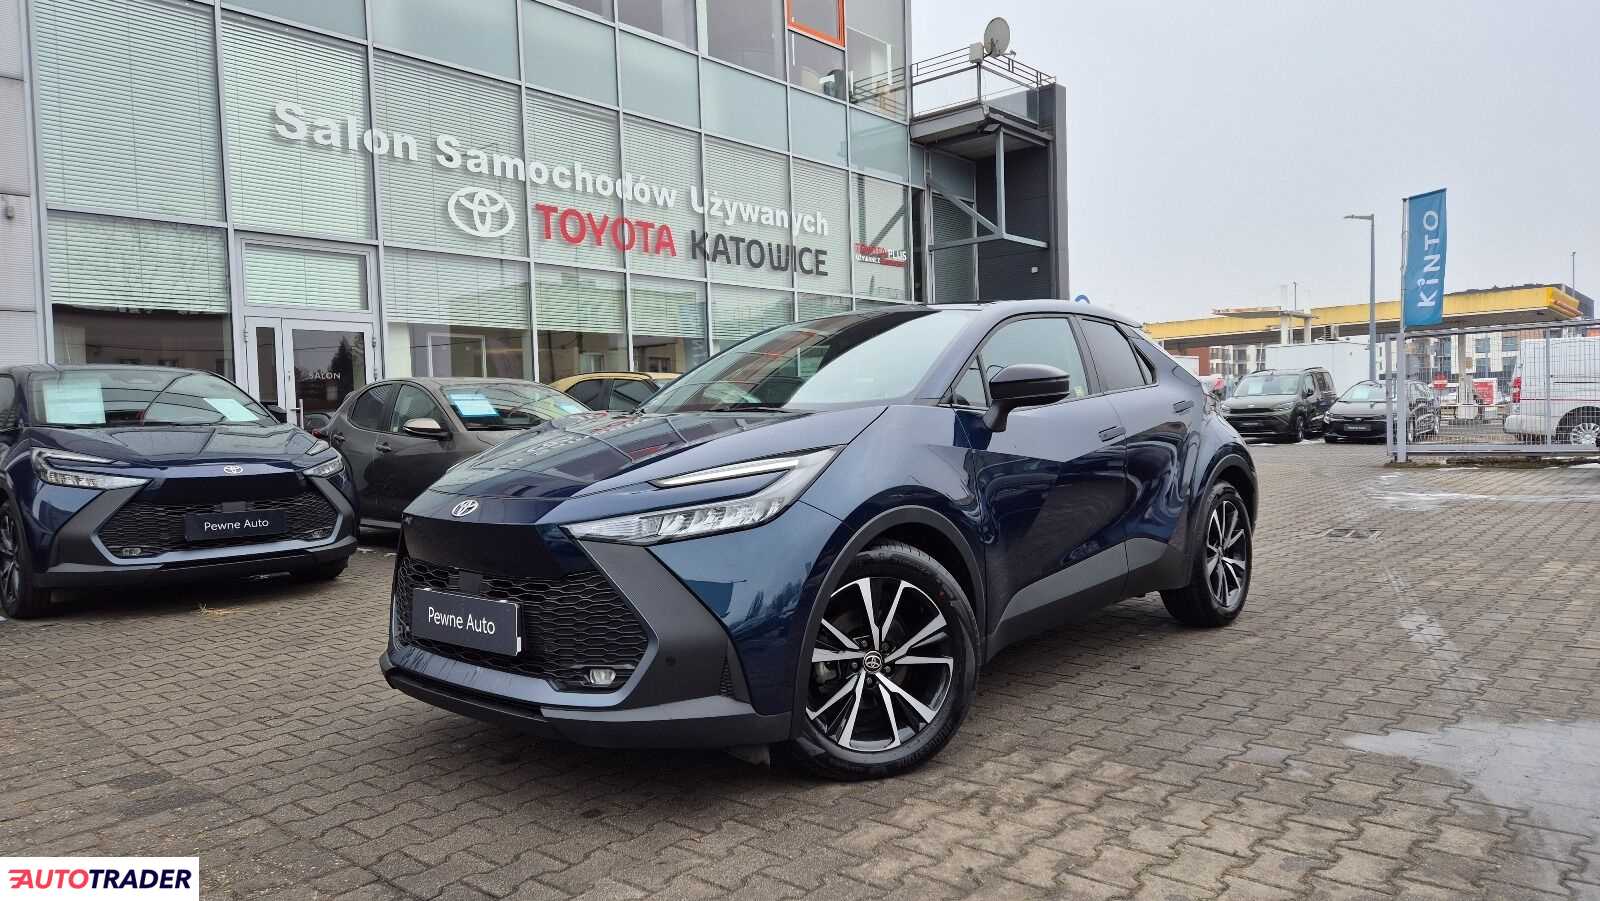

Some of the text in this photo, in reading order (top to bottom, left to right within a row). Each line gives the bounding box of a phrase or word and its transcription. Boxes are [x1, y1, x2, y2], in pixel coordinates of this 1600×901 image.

[274, 100, 829, 236] Salon Samochodów Używanych
[535, 202, 829, 277] TOYOTA KATOWICE
[887, 247, 907, 261] PLUS
[309, 371, 341, 380] SALON
[204, 519, 269, 532] Pewne Auto
[428, 606, 496, 635] Pewne Auto
